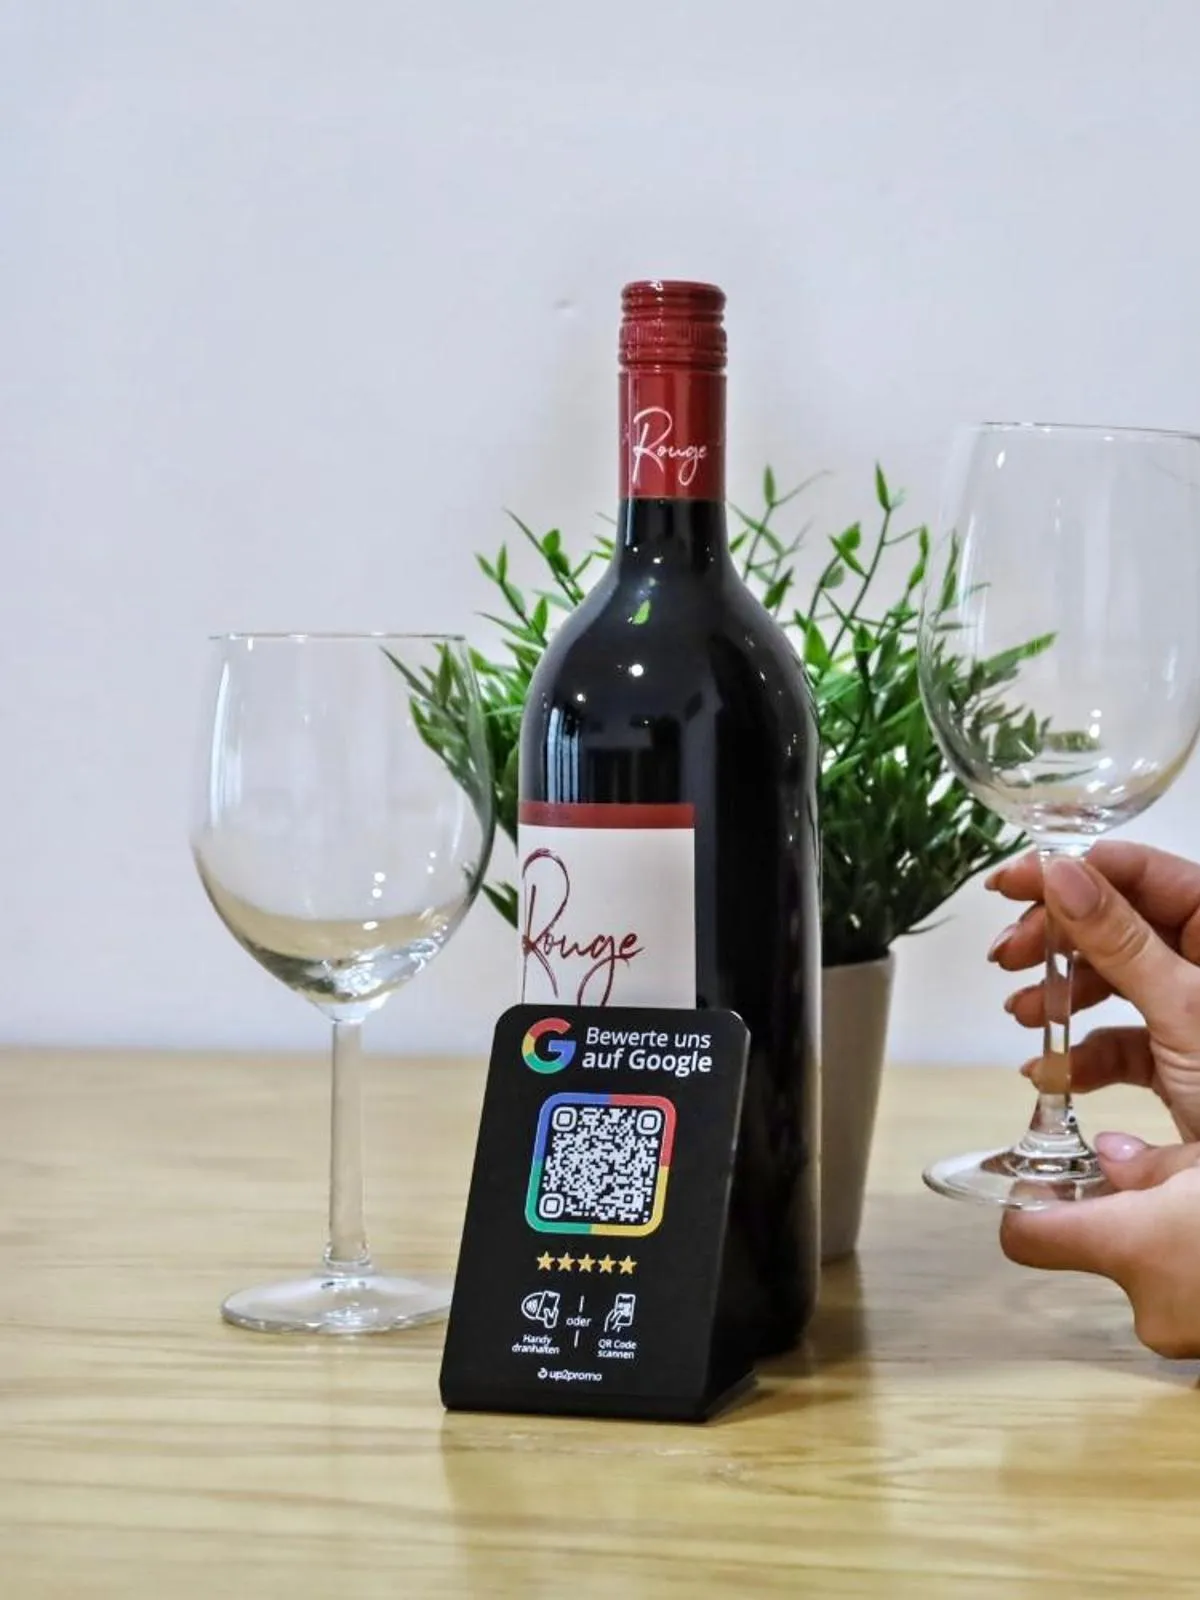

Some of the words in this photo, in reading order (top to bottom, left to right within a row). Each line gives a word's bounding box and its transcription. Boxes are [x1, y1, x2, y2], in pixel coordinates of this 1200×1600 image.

[632, 405, 709, 486] Rouge
[521, 848, 646, 1007] Rouge
[585, 1026, 669, 1048] Bewerte
[674, 1033, 712, 1049] uns
[581, 1048, 625, 1069] auf
[628, 1049, 713, 1078] Google
[566, 1316, 592, 1327] oder
[522, 1334, 552, 1345] Handy
[598, 1339, 612, 1350] QR
[614, 1340, 637, 1350] Code
[511, 1342, 560, 1354] dranhalten
[597, 1349, 634, 1359] scannen
